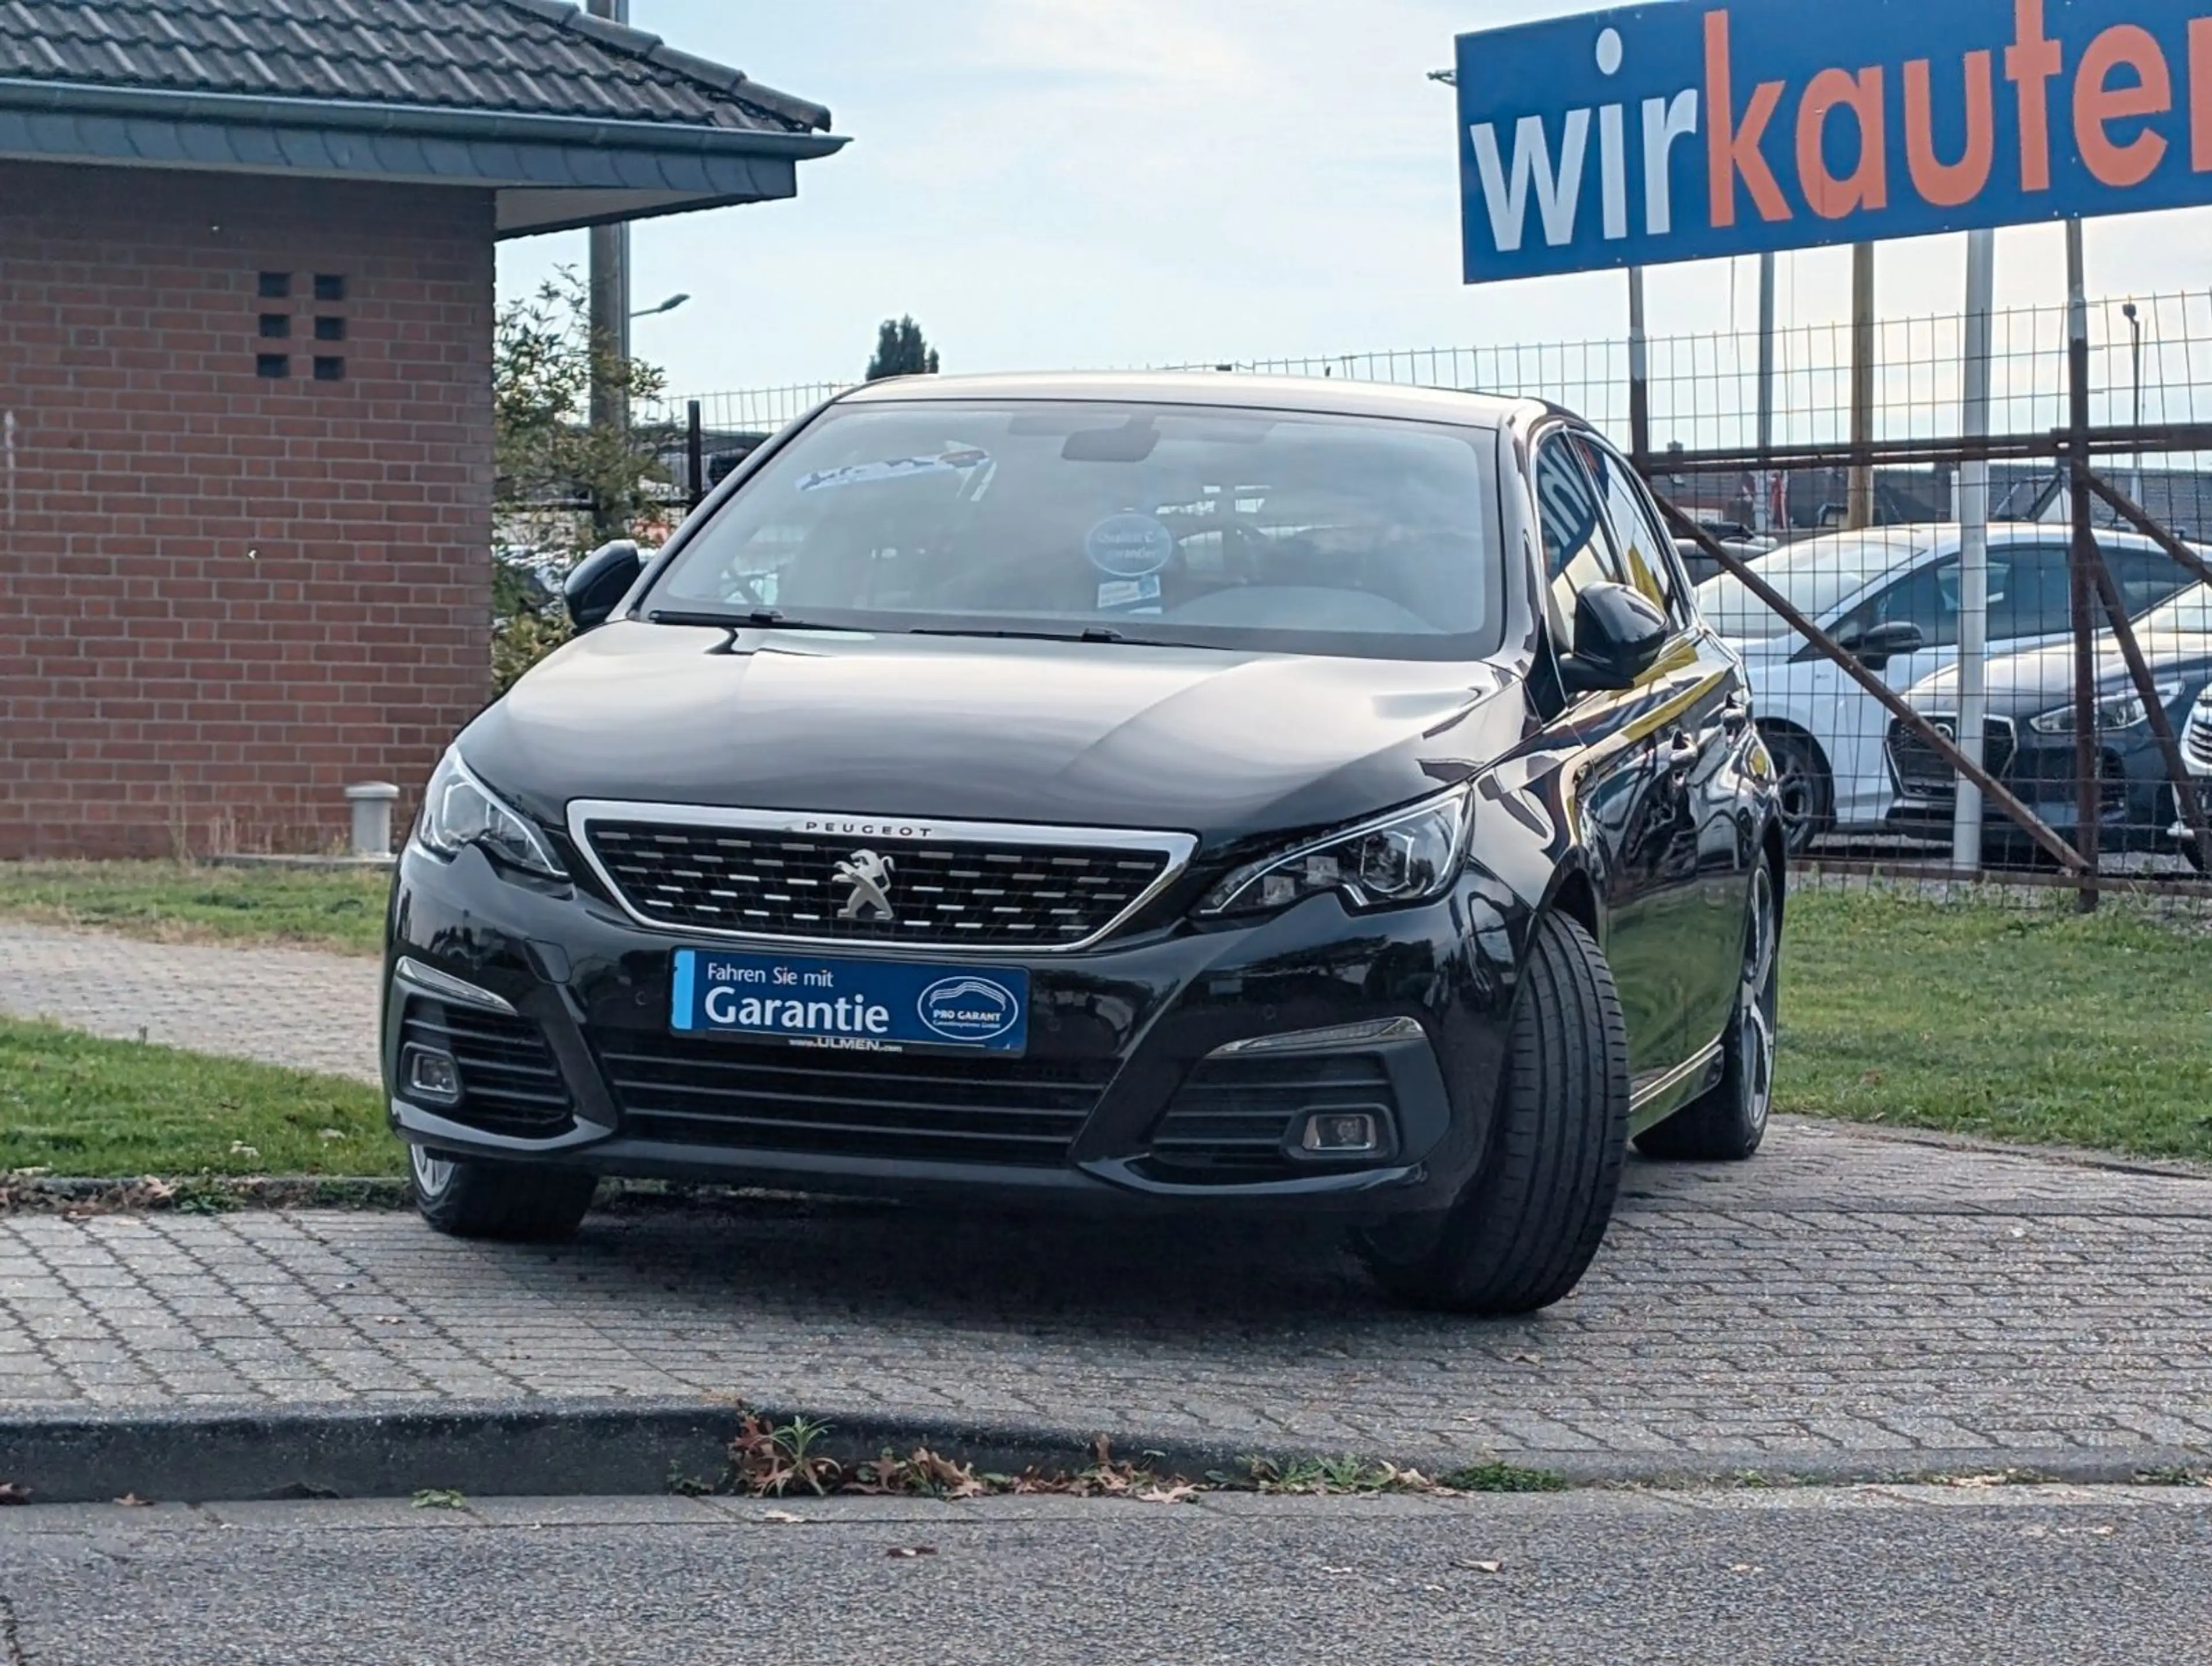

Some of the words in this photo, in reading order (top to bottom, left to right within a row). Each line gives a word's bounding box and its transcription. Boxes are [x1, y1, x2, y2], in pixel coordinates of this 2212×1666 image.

[1470, 0, 2212, 252] wirkaufe
[806, 821, 932, 837] PEUGEOT
[708, 962, 766, 983] Fahren
[772, 967, 798, 985] Sie
[804, 970, 834, 987] mit
[705, 986, 889, 1033] Garantie
[933, 1009, 955, 1019] PRO
[957, 1010, 1002, 1022] GARANT
